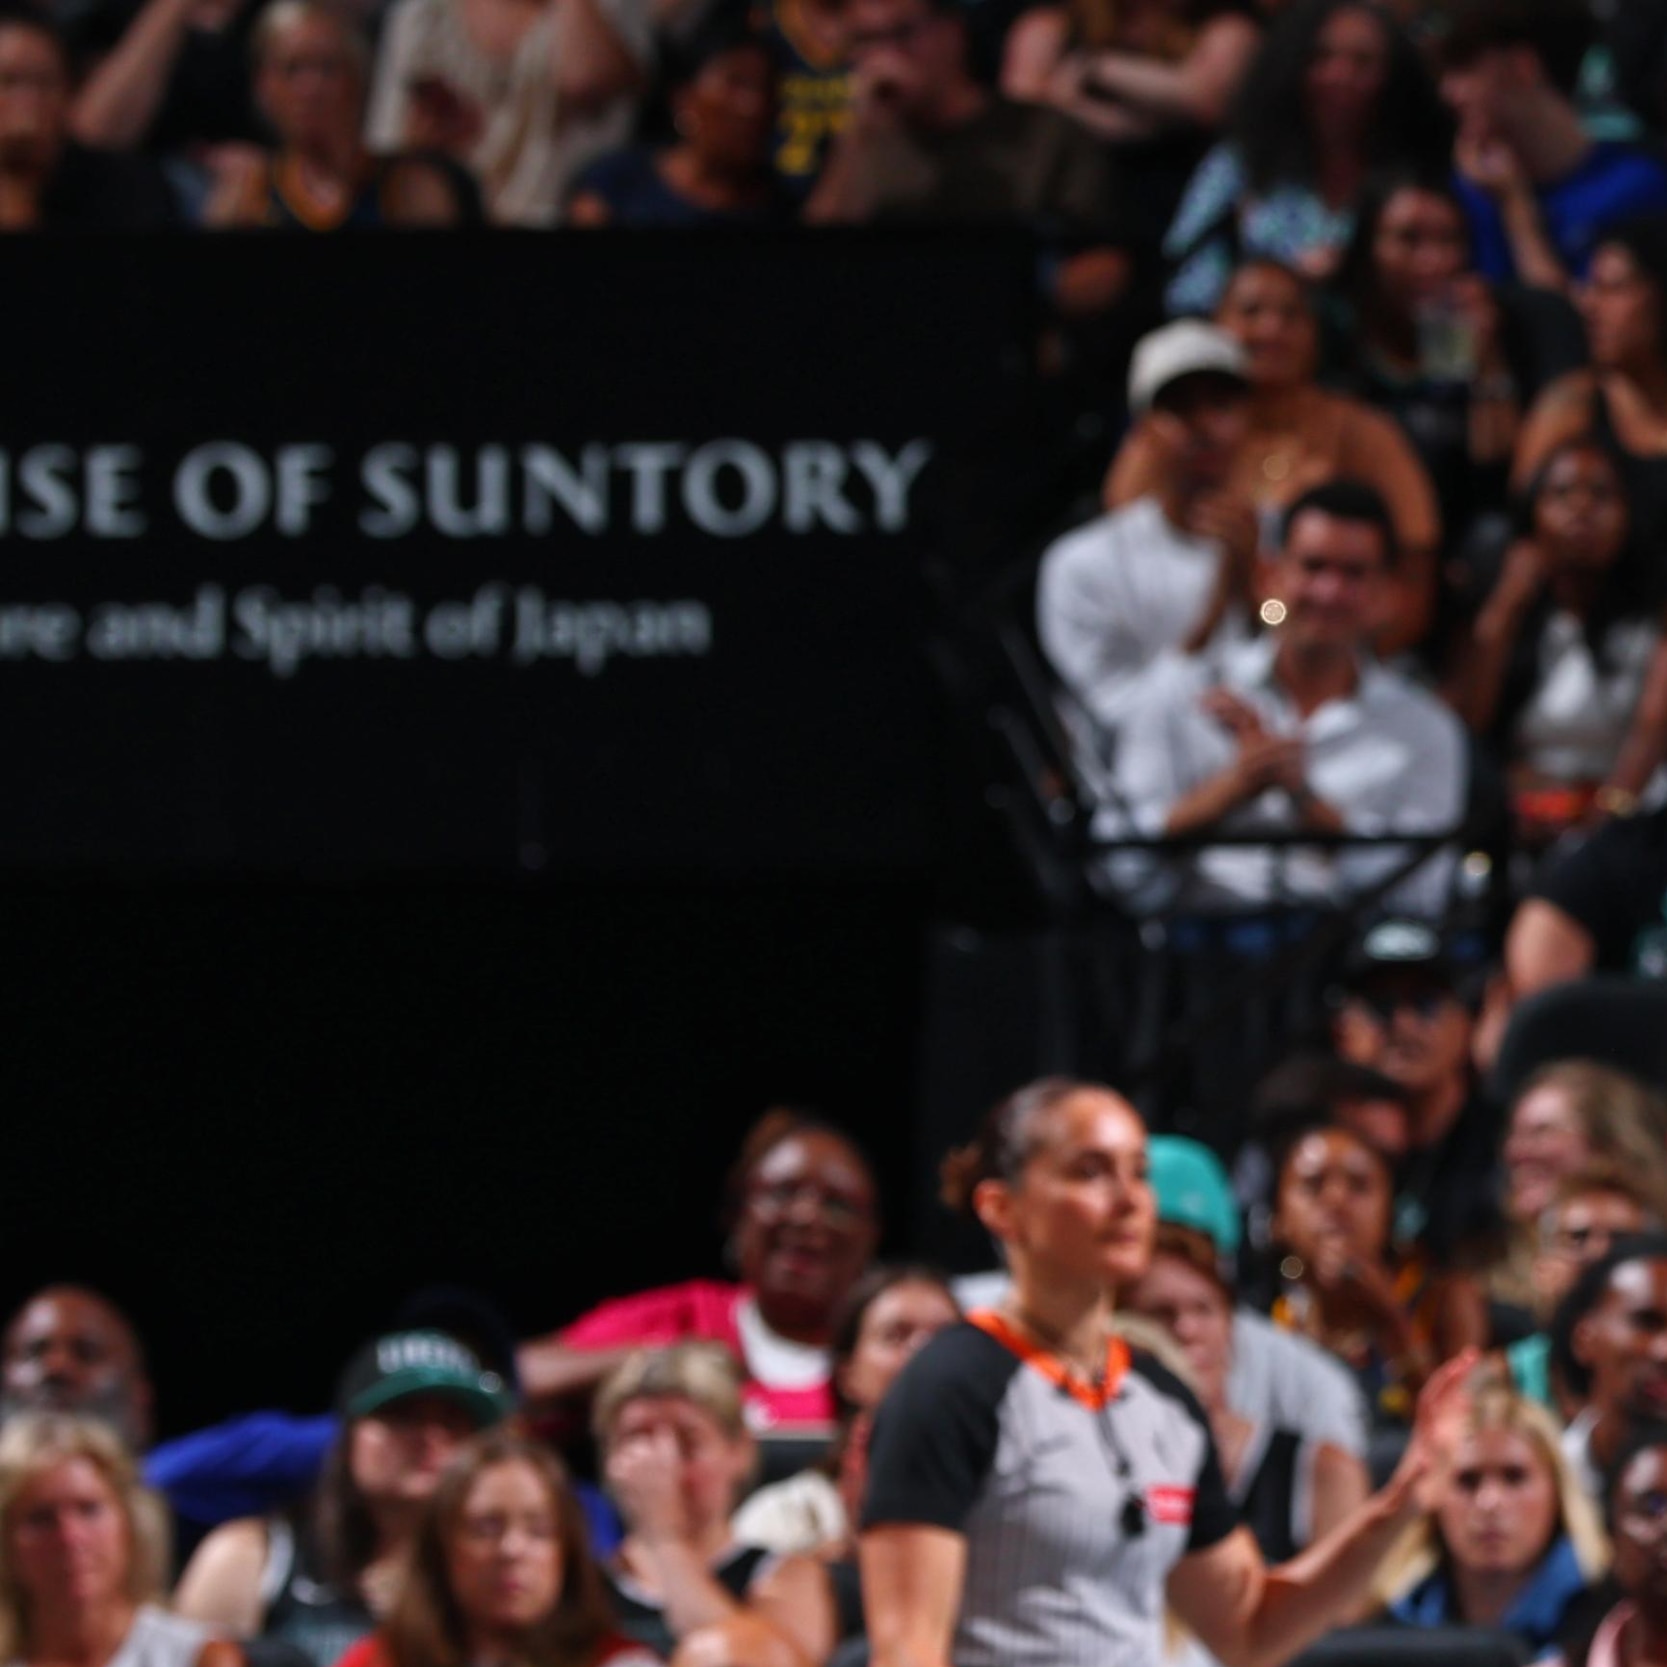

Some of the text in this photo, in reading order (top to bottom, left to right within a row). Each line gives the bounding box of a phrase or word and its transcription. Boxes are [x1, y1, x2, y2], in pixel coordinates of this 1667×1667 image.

[174, 439, 333, 541] OF
[358, 437, 933, 539] SUNTORY
[85, 581, 225, 661] and
[231, 583, 413, 678] Spirit
[425, 580, 512, 661] of
[513, 583, 713, 677] Japan
